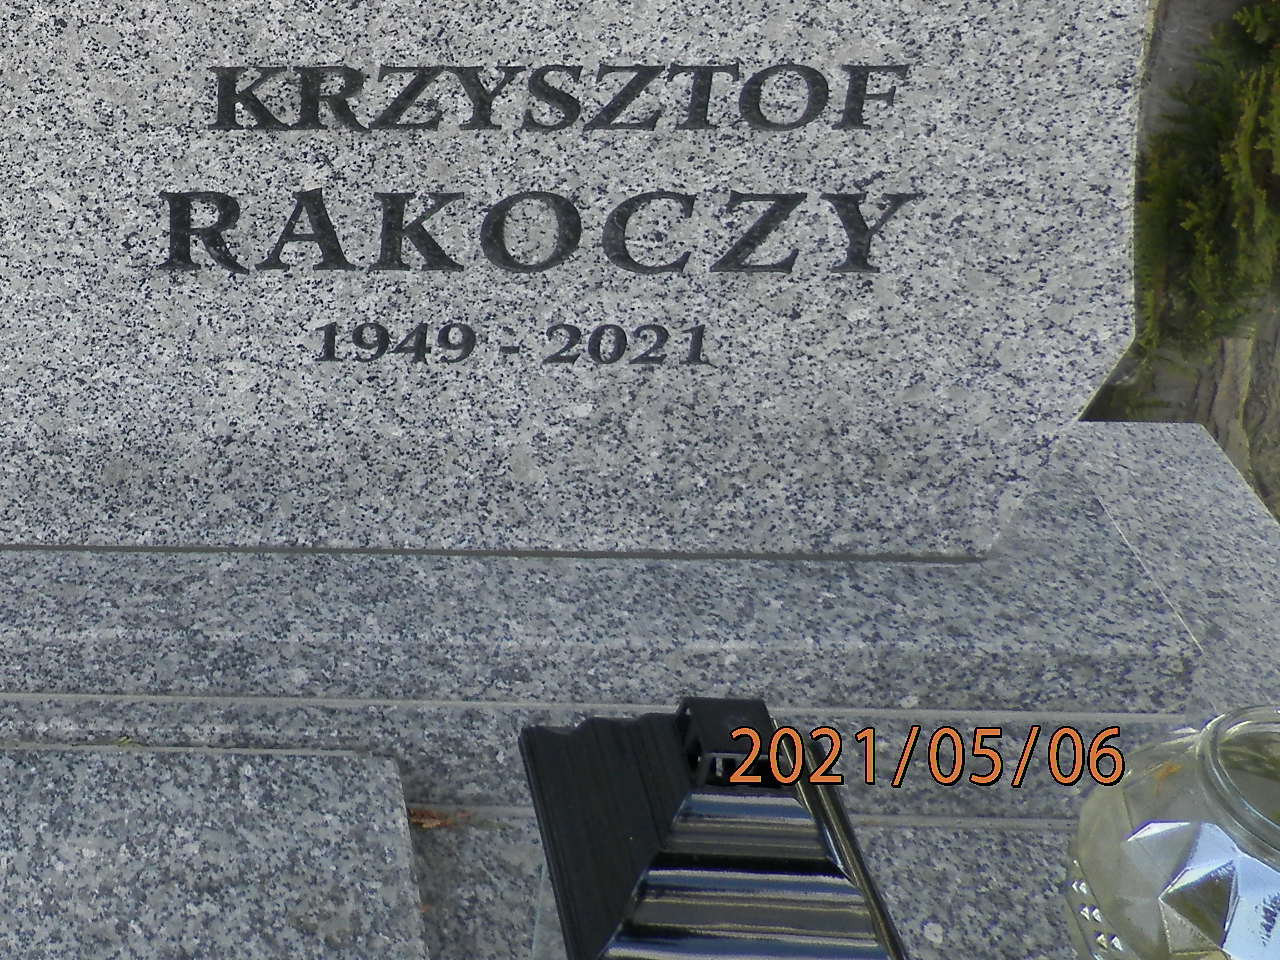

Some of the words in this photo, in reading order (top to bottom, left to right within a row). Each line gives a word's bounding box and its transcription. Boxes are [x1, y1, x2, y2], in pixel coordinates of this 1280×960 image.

[206, 62, 910, 132] KRZYSZTOF
[157, 187, 920, 275] RAKOCZY
[319, 322, 477, 365] 1949
[542, 322, 718, 366] 2021
